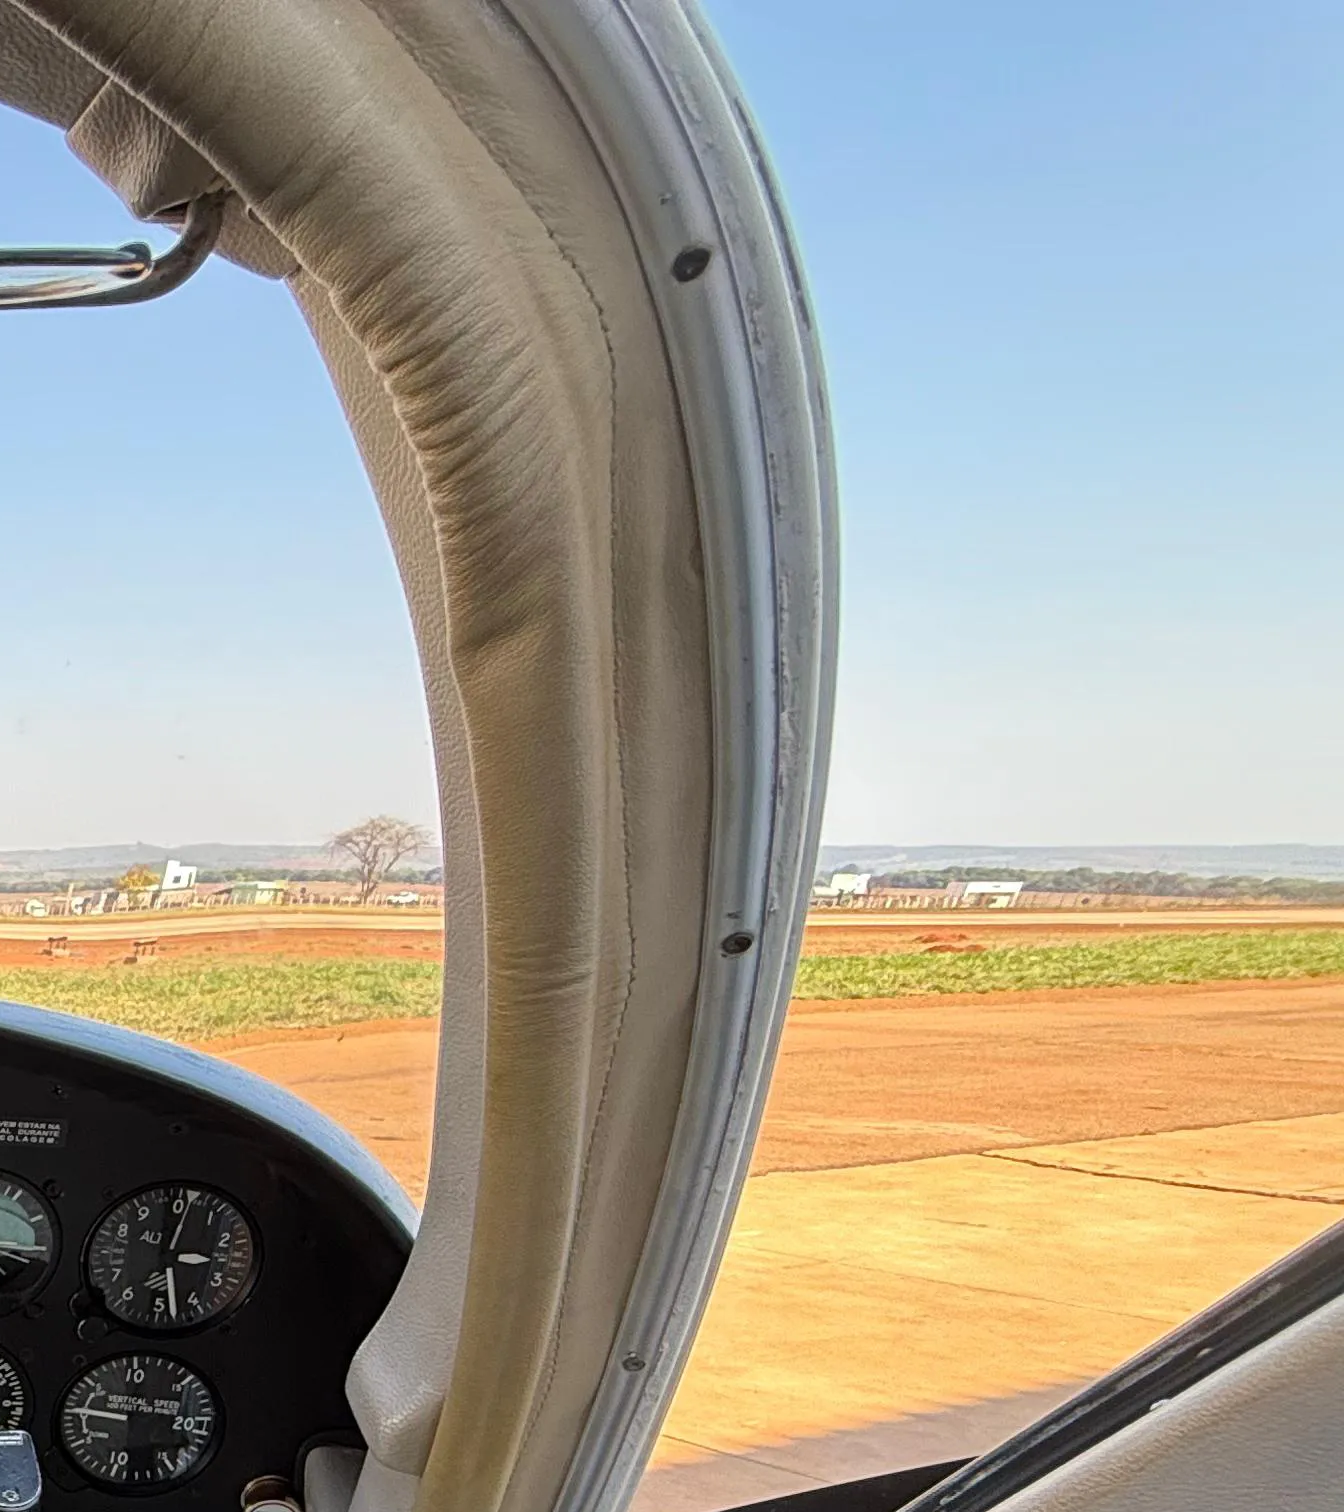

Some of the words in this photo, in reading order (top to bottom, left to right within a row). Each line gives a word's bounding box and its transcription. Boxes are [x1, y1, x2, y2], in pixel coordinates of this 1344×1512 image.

[17, 1128, 60, 1138] DURANTE
[18, 1121, 47, 1130] ESTAR
[137, 1205, 150, 1222] 9
[172, 1198, 185, 1215] 0
[207, 1210, 214, 1227] 1
[117, 1223, 129, 1238] 8
[218, 1231, 231, 1248] 2
[112, 1267, 123, 1284] 7
[210, 1272, 224, 1288] 3
[122, 1286, 135, 1301] 6
[186, 1291, 201, 1307] 4
[152, 1297, 166, 1313] 5
[125, 1368, 145, 1384] 10
[171, 1383, 182, 1392] 15
[1, 1399, 12, 1408] 0
[108, 1395, 149, 1406] VERTICAL
[153, 1398, 181, 1410] SPEED
[119, 1403, 138, 1412] FEET
[138, 1405, 153, 1414] PER
[171, 1416, 195, 1432] 20
[109, 1450, 129, 1466] 10
